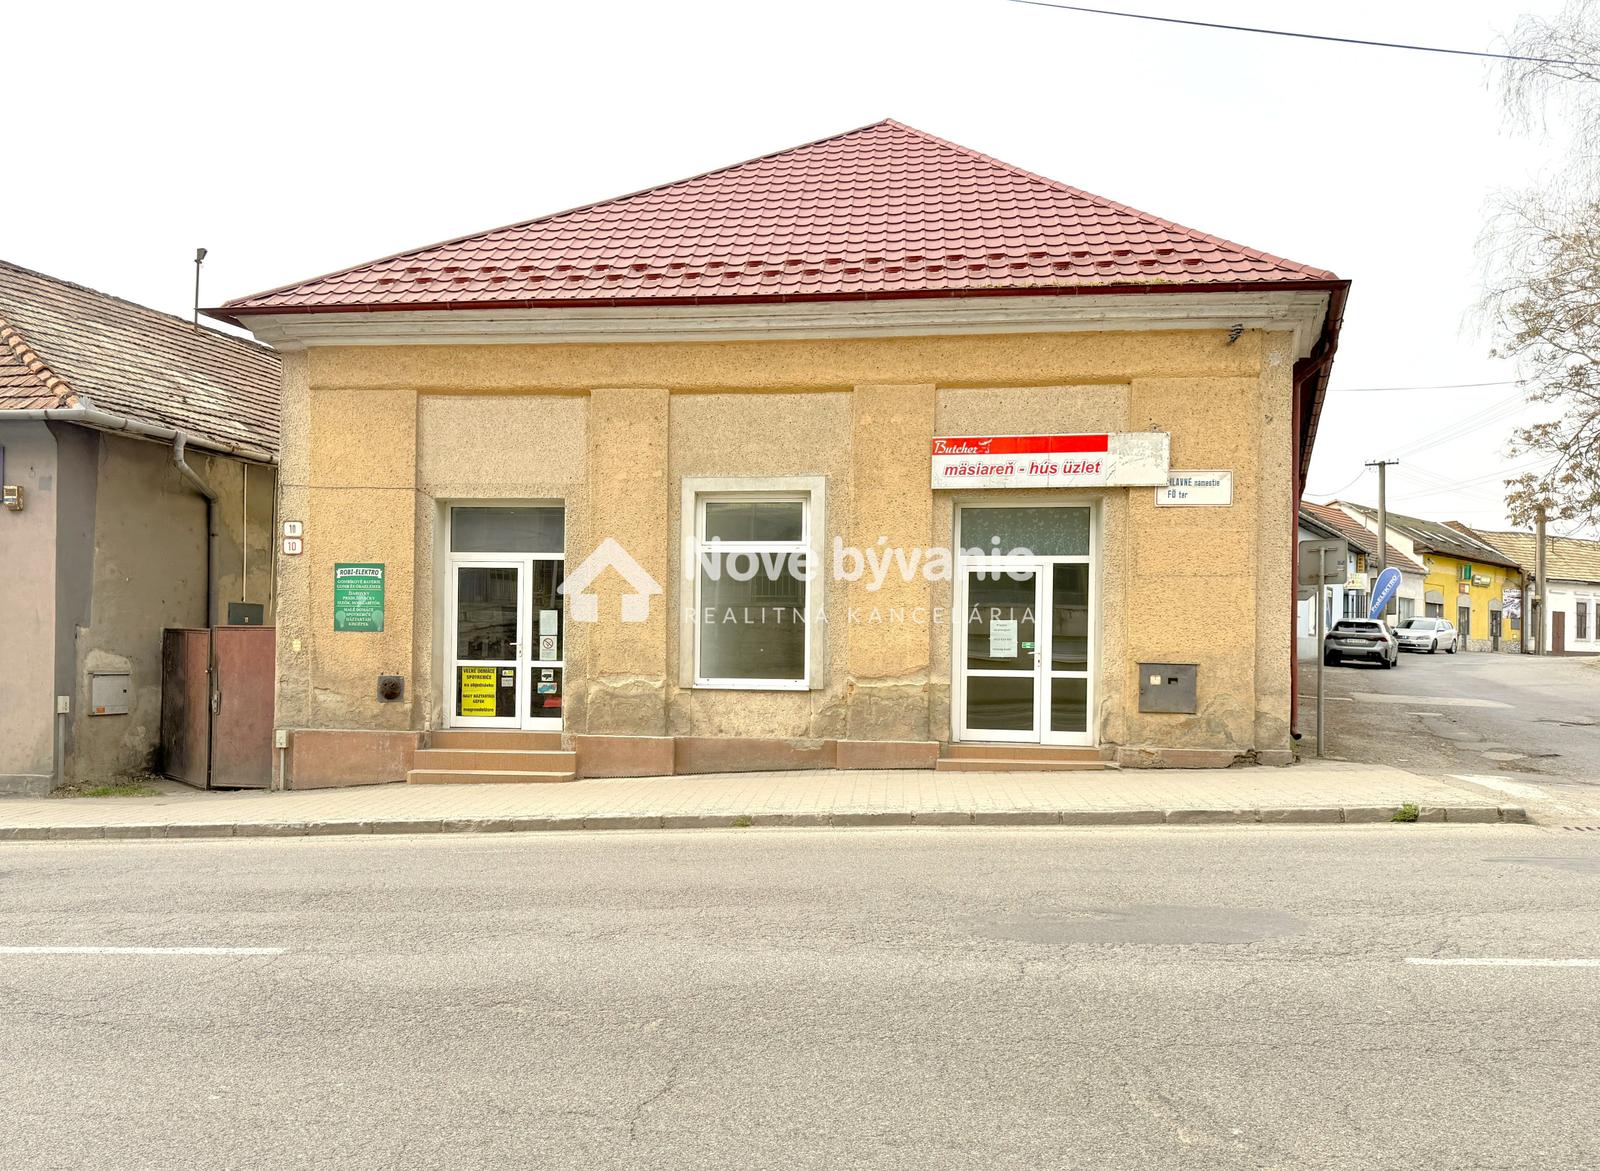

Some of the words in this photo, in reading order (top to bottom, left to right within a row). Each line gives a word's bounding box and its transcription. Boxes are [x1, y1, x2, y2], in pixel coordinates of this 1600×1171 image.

[934, 440, 978, 454] Butcher
[944, 462, 1014, 476] mäsiareň
[1029, 461, 1058, 475] hús
[1063, 460, 1101, 474] üzlet
[288, 541, 296, 551] 10
